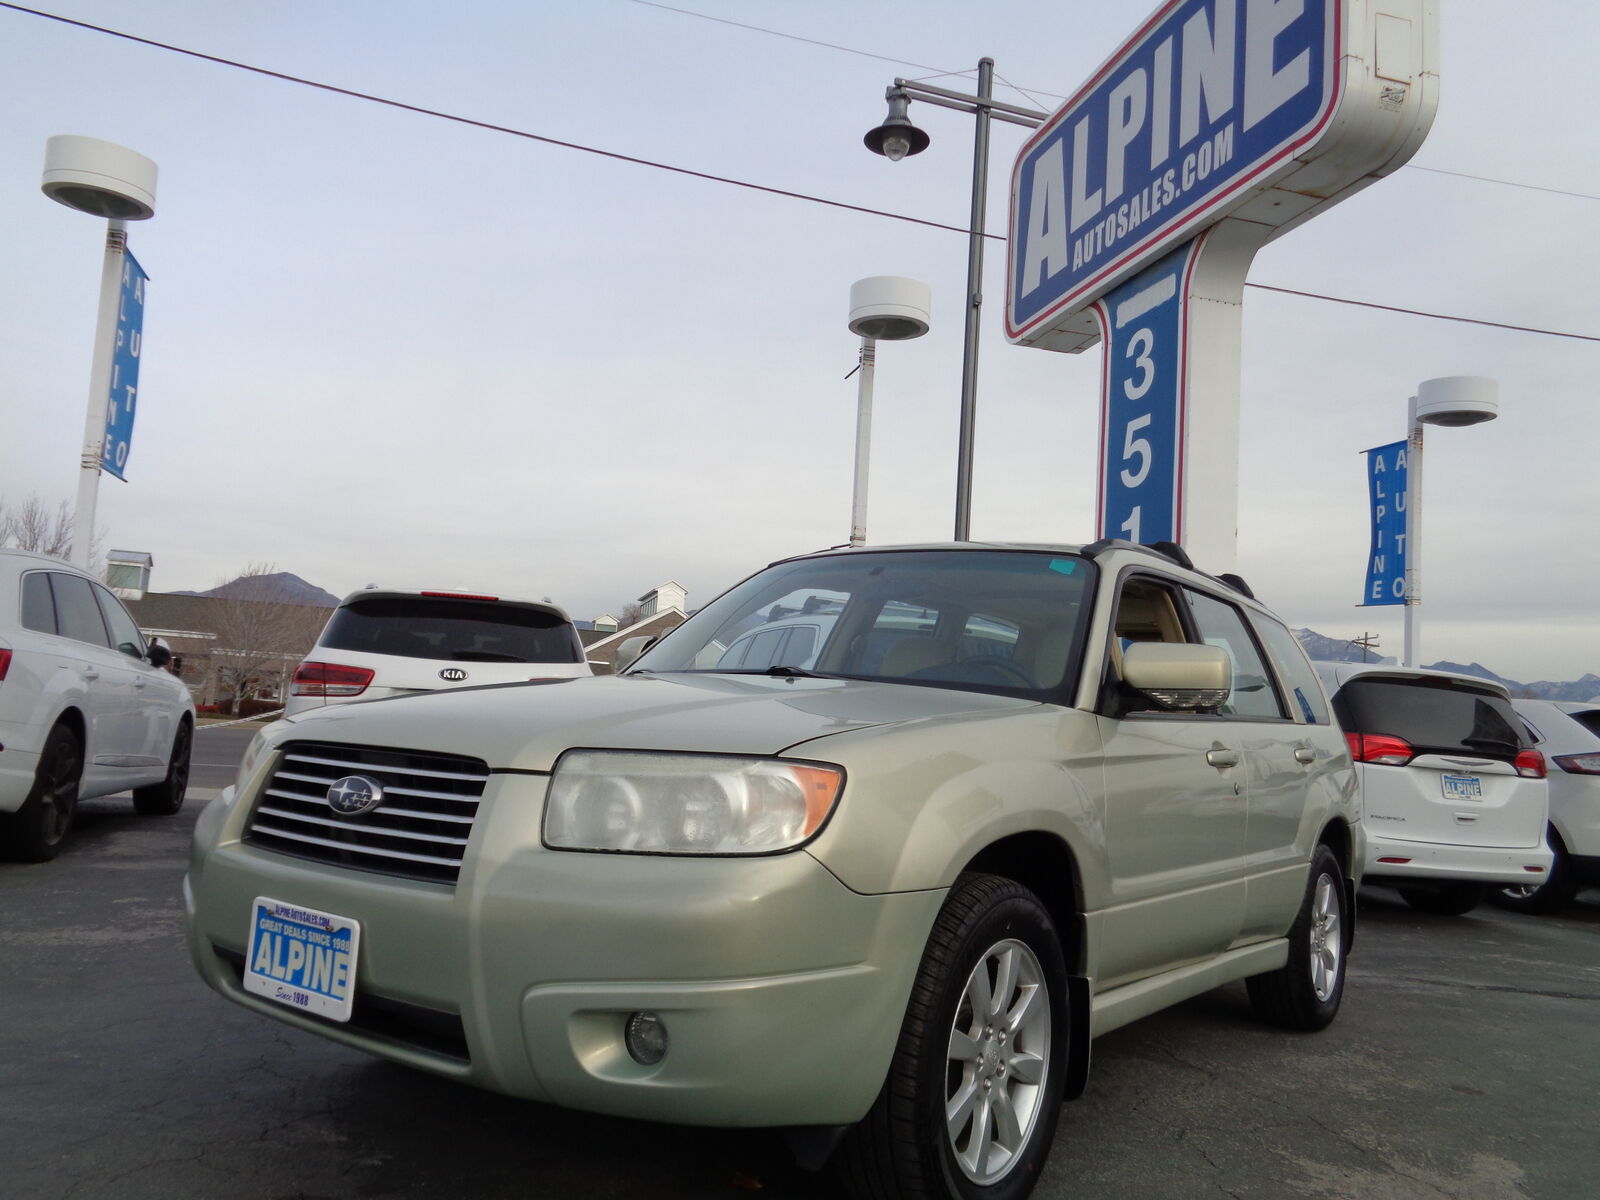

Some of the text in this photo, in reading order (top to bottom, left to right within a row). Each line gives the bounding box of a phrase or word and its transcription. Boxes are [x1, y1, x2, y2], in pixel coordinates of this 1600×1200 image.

[1021, 0, 1310, 298] ALPINE
[1072, 123, 1234, 272] AUTOSALES.COM
[104, 261, 130, 460] ALPINE
[115, 277, 143, 468] AUTO
[1372, 455, 1386, 599] ALPINE
[1392, 450, 1407, 598] AUTO
[443, 670, 463, 679] KIA
[1445, 782, 1481, 796] ALPINE
[254, 932, 349, 998] ALPINE
[260, 918, 283, 933] GREAT
[284, 924, 307, 940] DEALS
[308, 931, 330, 946] SINCE
[275, 986, 309, 1007] Since 1988
